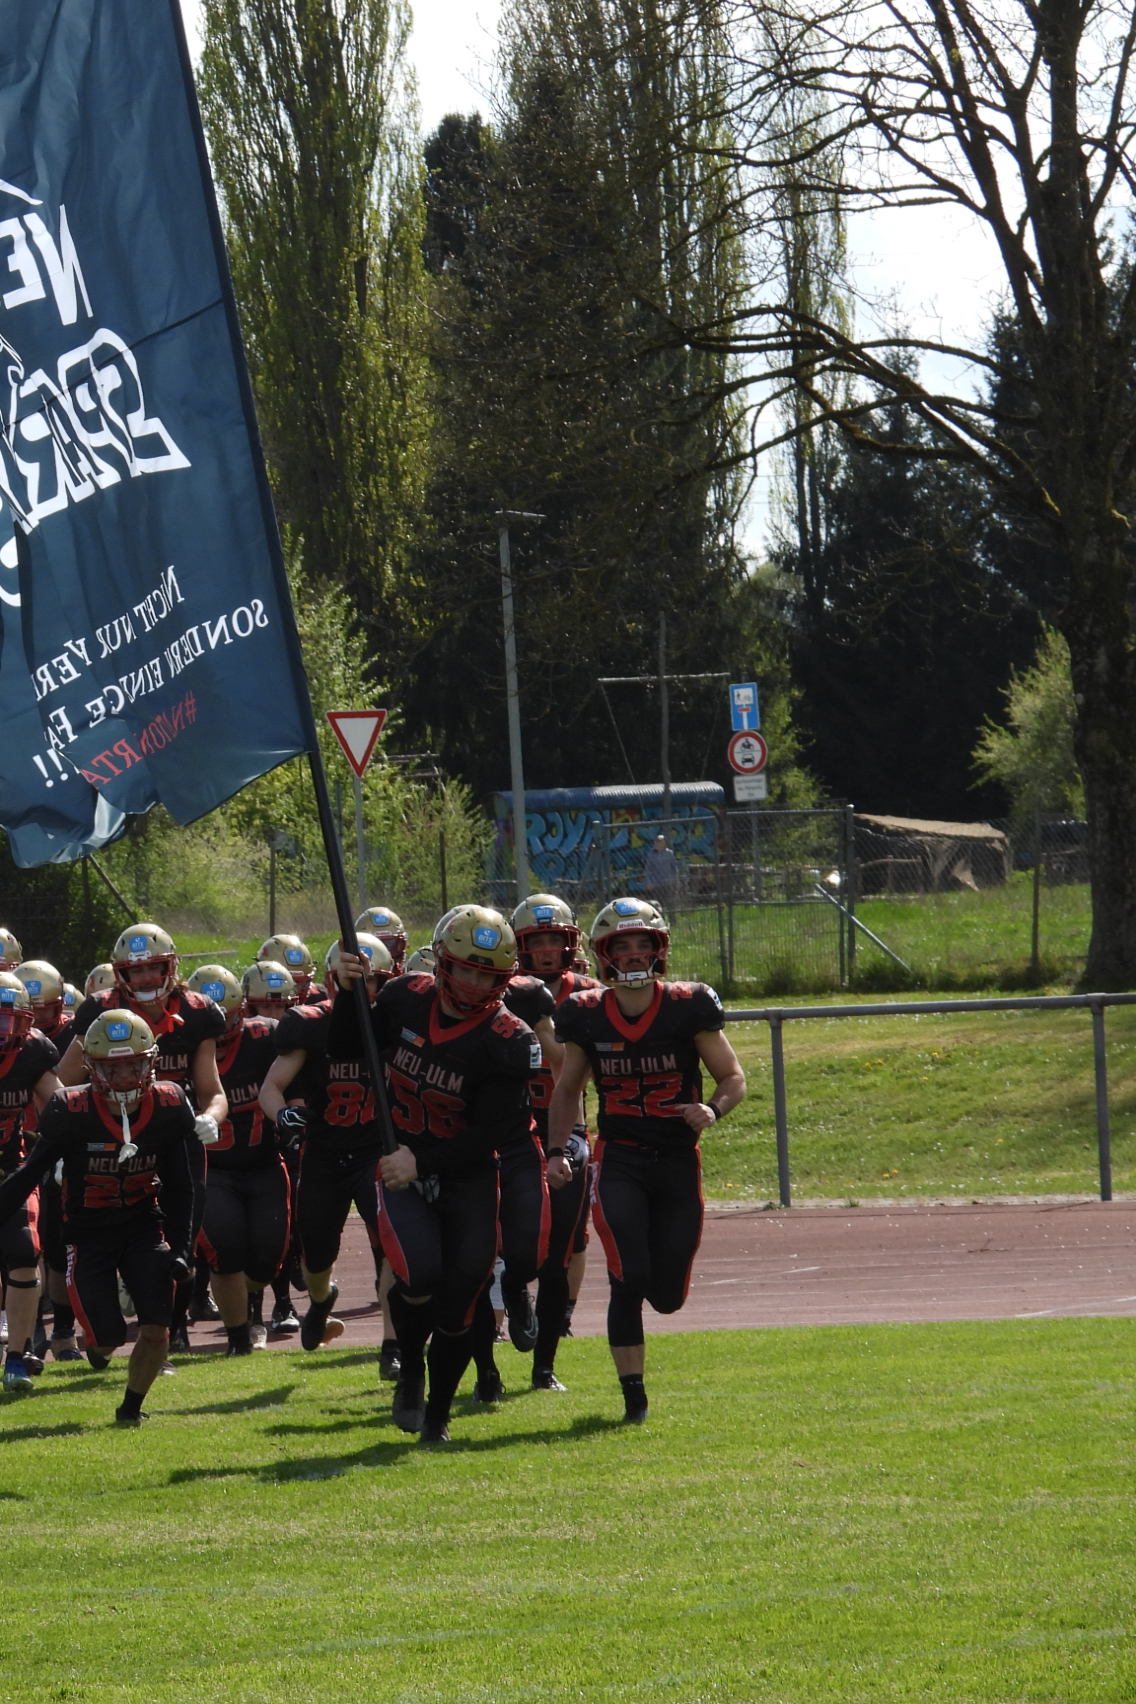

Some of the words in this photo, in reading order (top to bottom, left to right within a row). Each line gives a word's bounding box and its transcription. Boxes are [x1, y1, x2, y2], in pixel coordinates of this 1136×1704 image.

[394, 1046, 465, 1093] NEU-ULM
[600, 1054, 677, 1076] NEU-ULM
[389, 1066, 466, 1138] 56
[601, 1072, 683, 1118] 22
[88, 1154, 156, 1174] NEU-ULM
